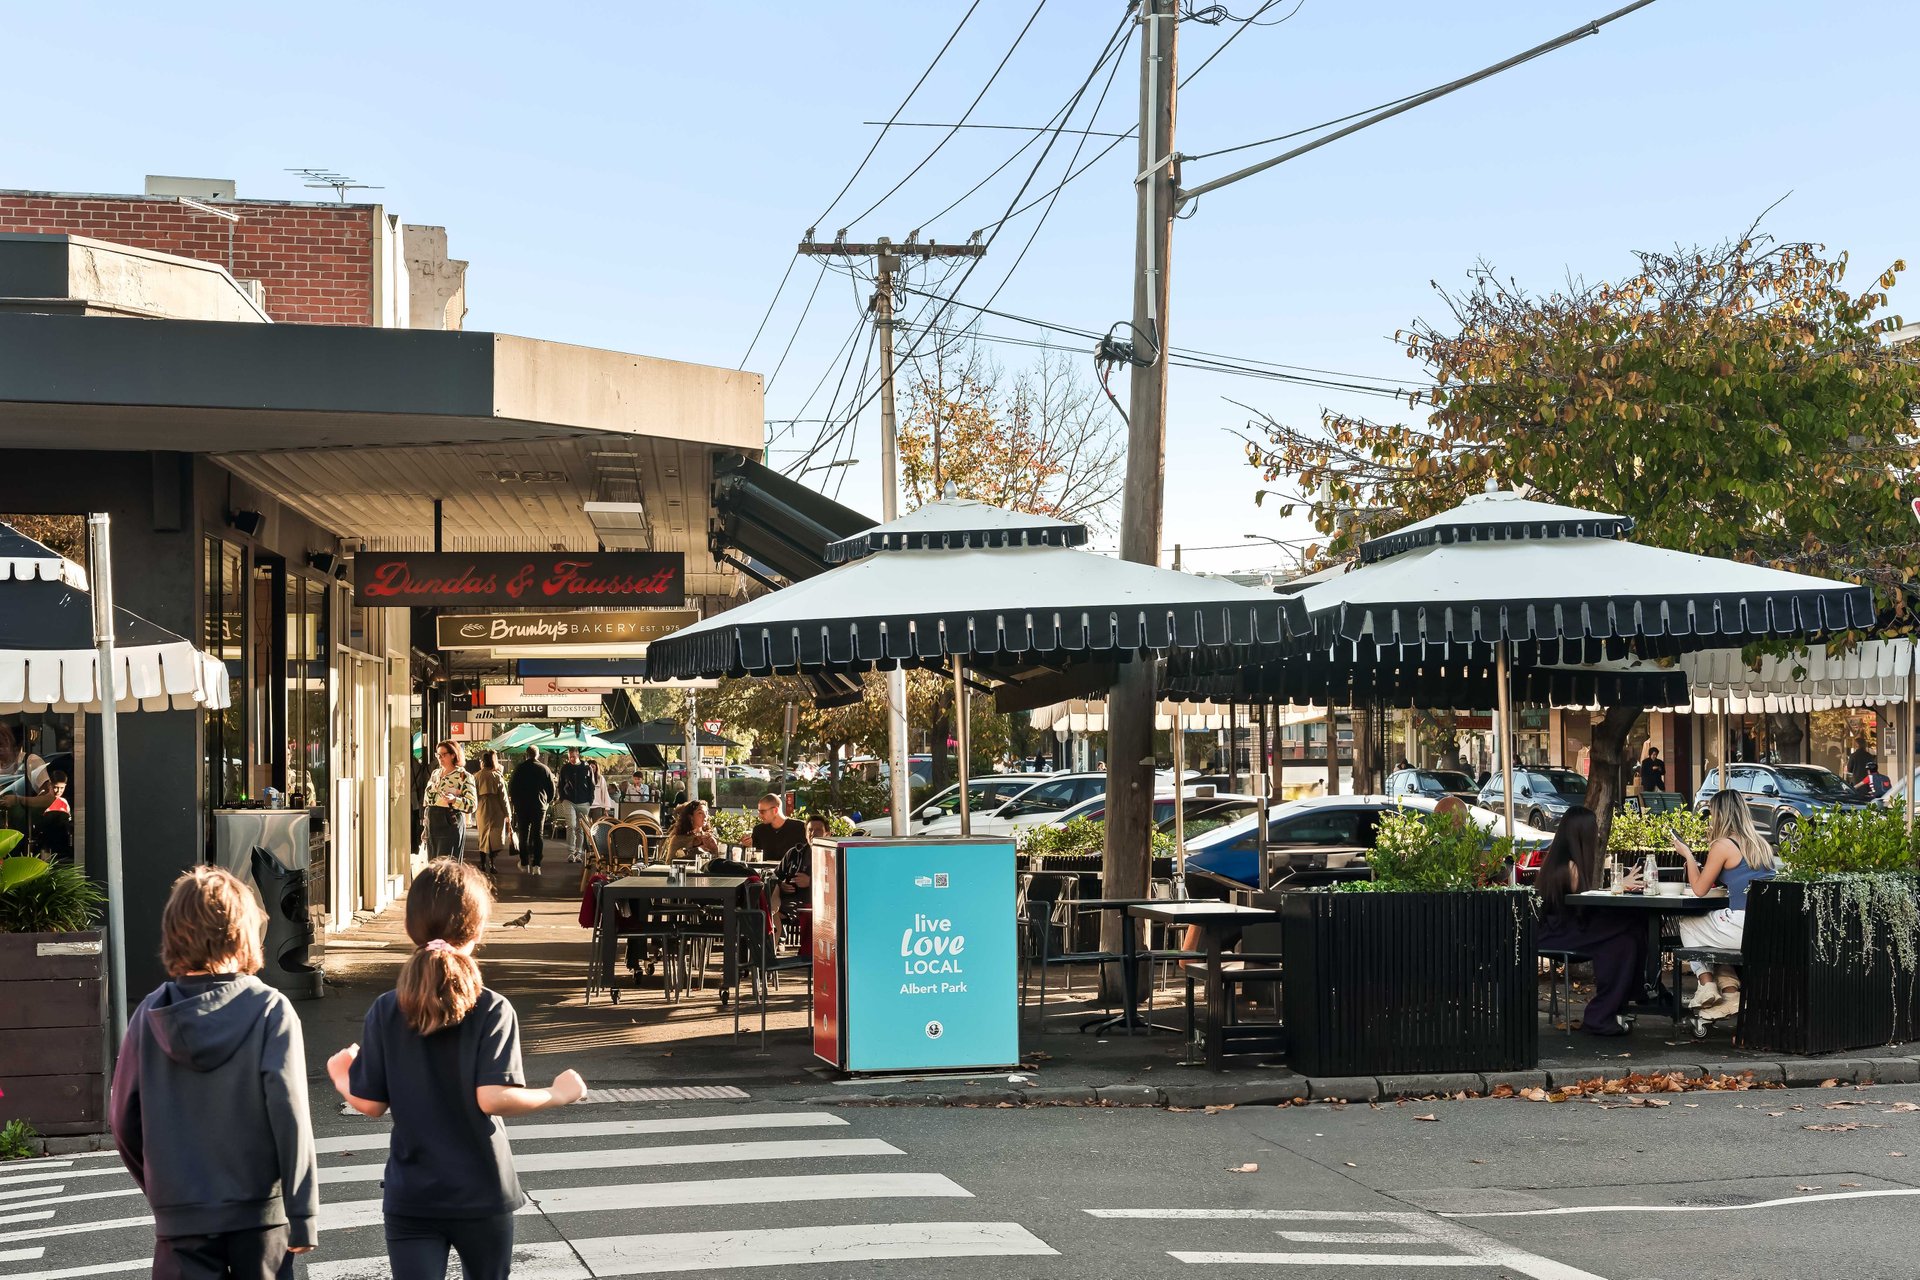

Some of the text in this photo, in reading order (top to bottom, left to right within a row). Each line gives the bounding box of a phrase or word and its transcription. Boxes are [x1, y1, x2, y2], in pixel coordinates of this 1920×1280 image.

[364, 560, 677, 599] Dundas & Faussett
[489, 619, 568, 641] Brumby's
[571, 623, 637, 634] BAKERY
[661, 624, 680, 632] 1975
[500, 705, 543, 713] avenue
[915, 913, 952, 932] live
[905, 960, 963, 975] LOCAL
[900, 981, 968, 995] Albert Park
